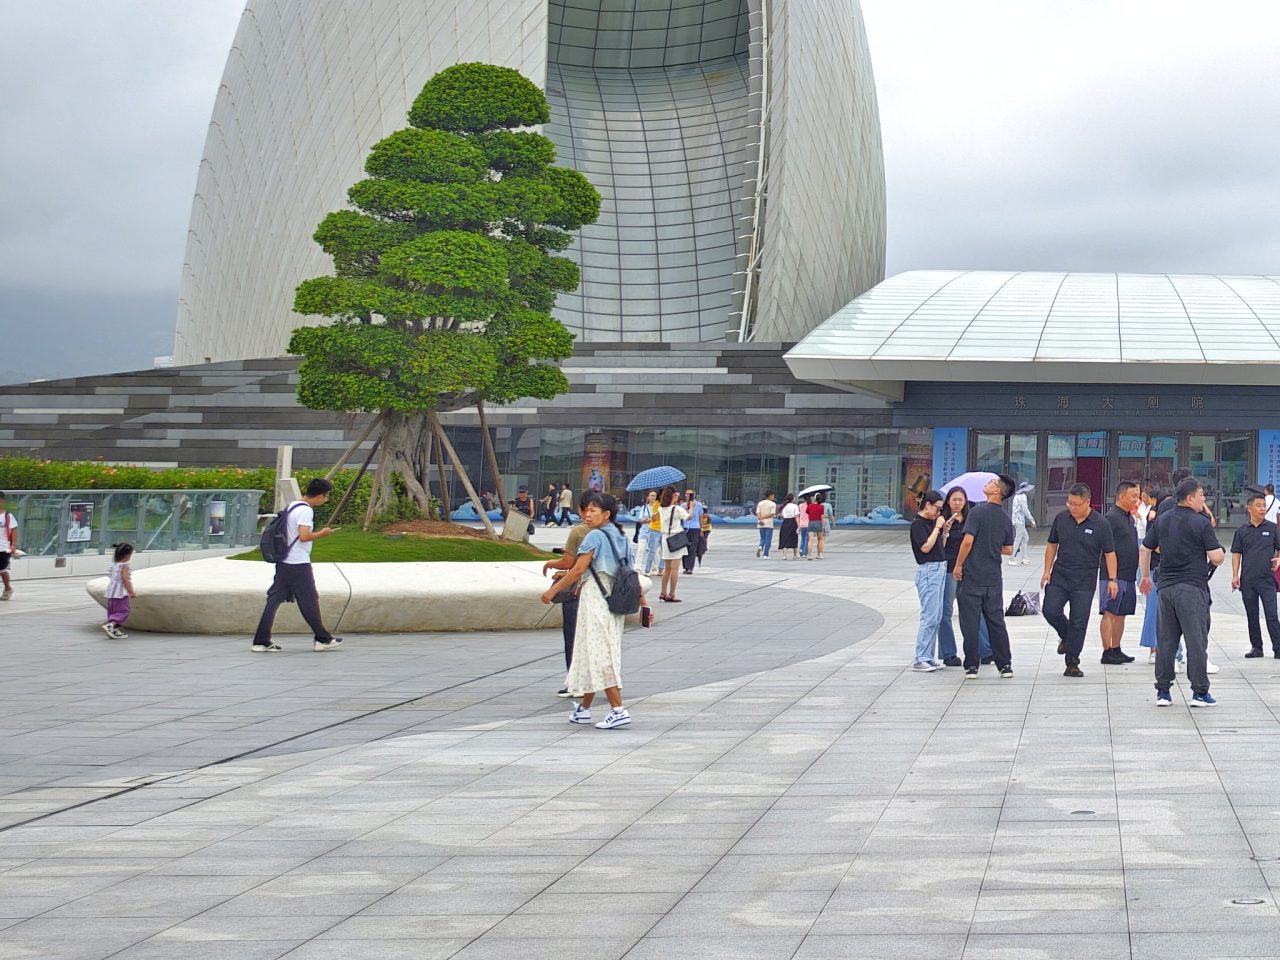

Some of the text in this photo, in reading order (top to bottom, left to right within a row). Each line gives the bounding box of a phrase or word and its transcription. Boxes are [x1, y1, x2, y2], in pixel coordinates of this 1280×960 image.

[1015, 396, 1204, 409] 珠海大剧院
